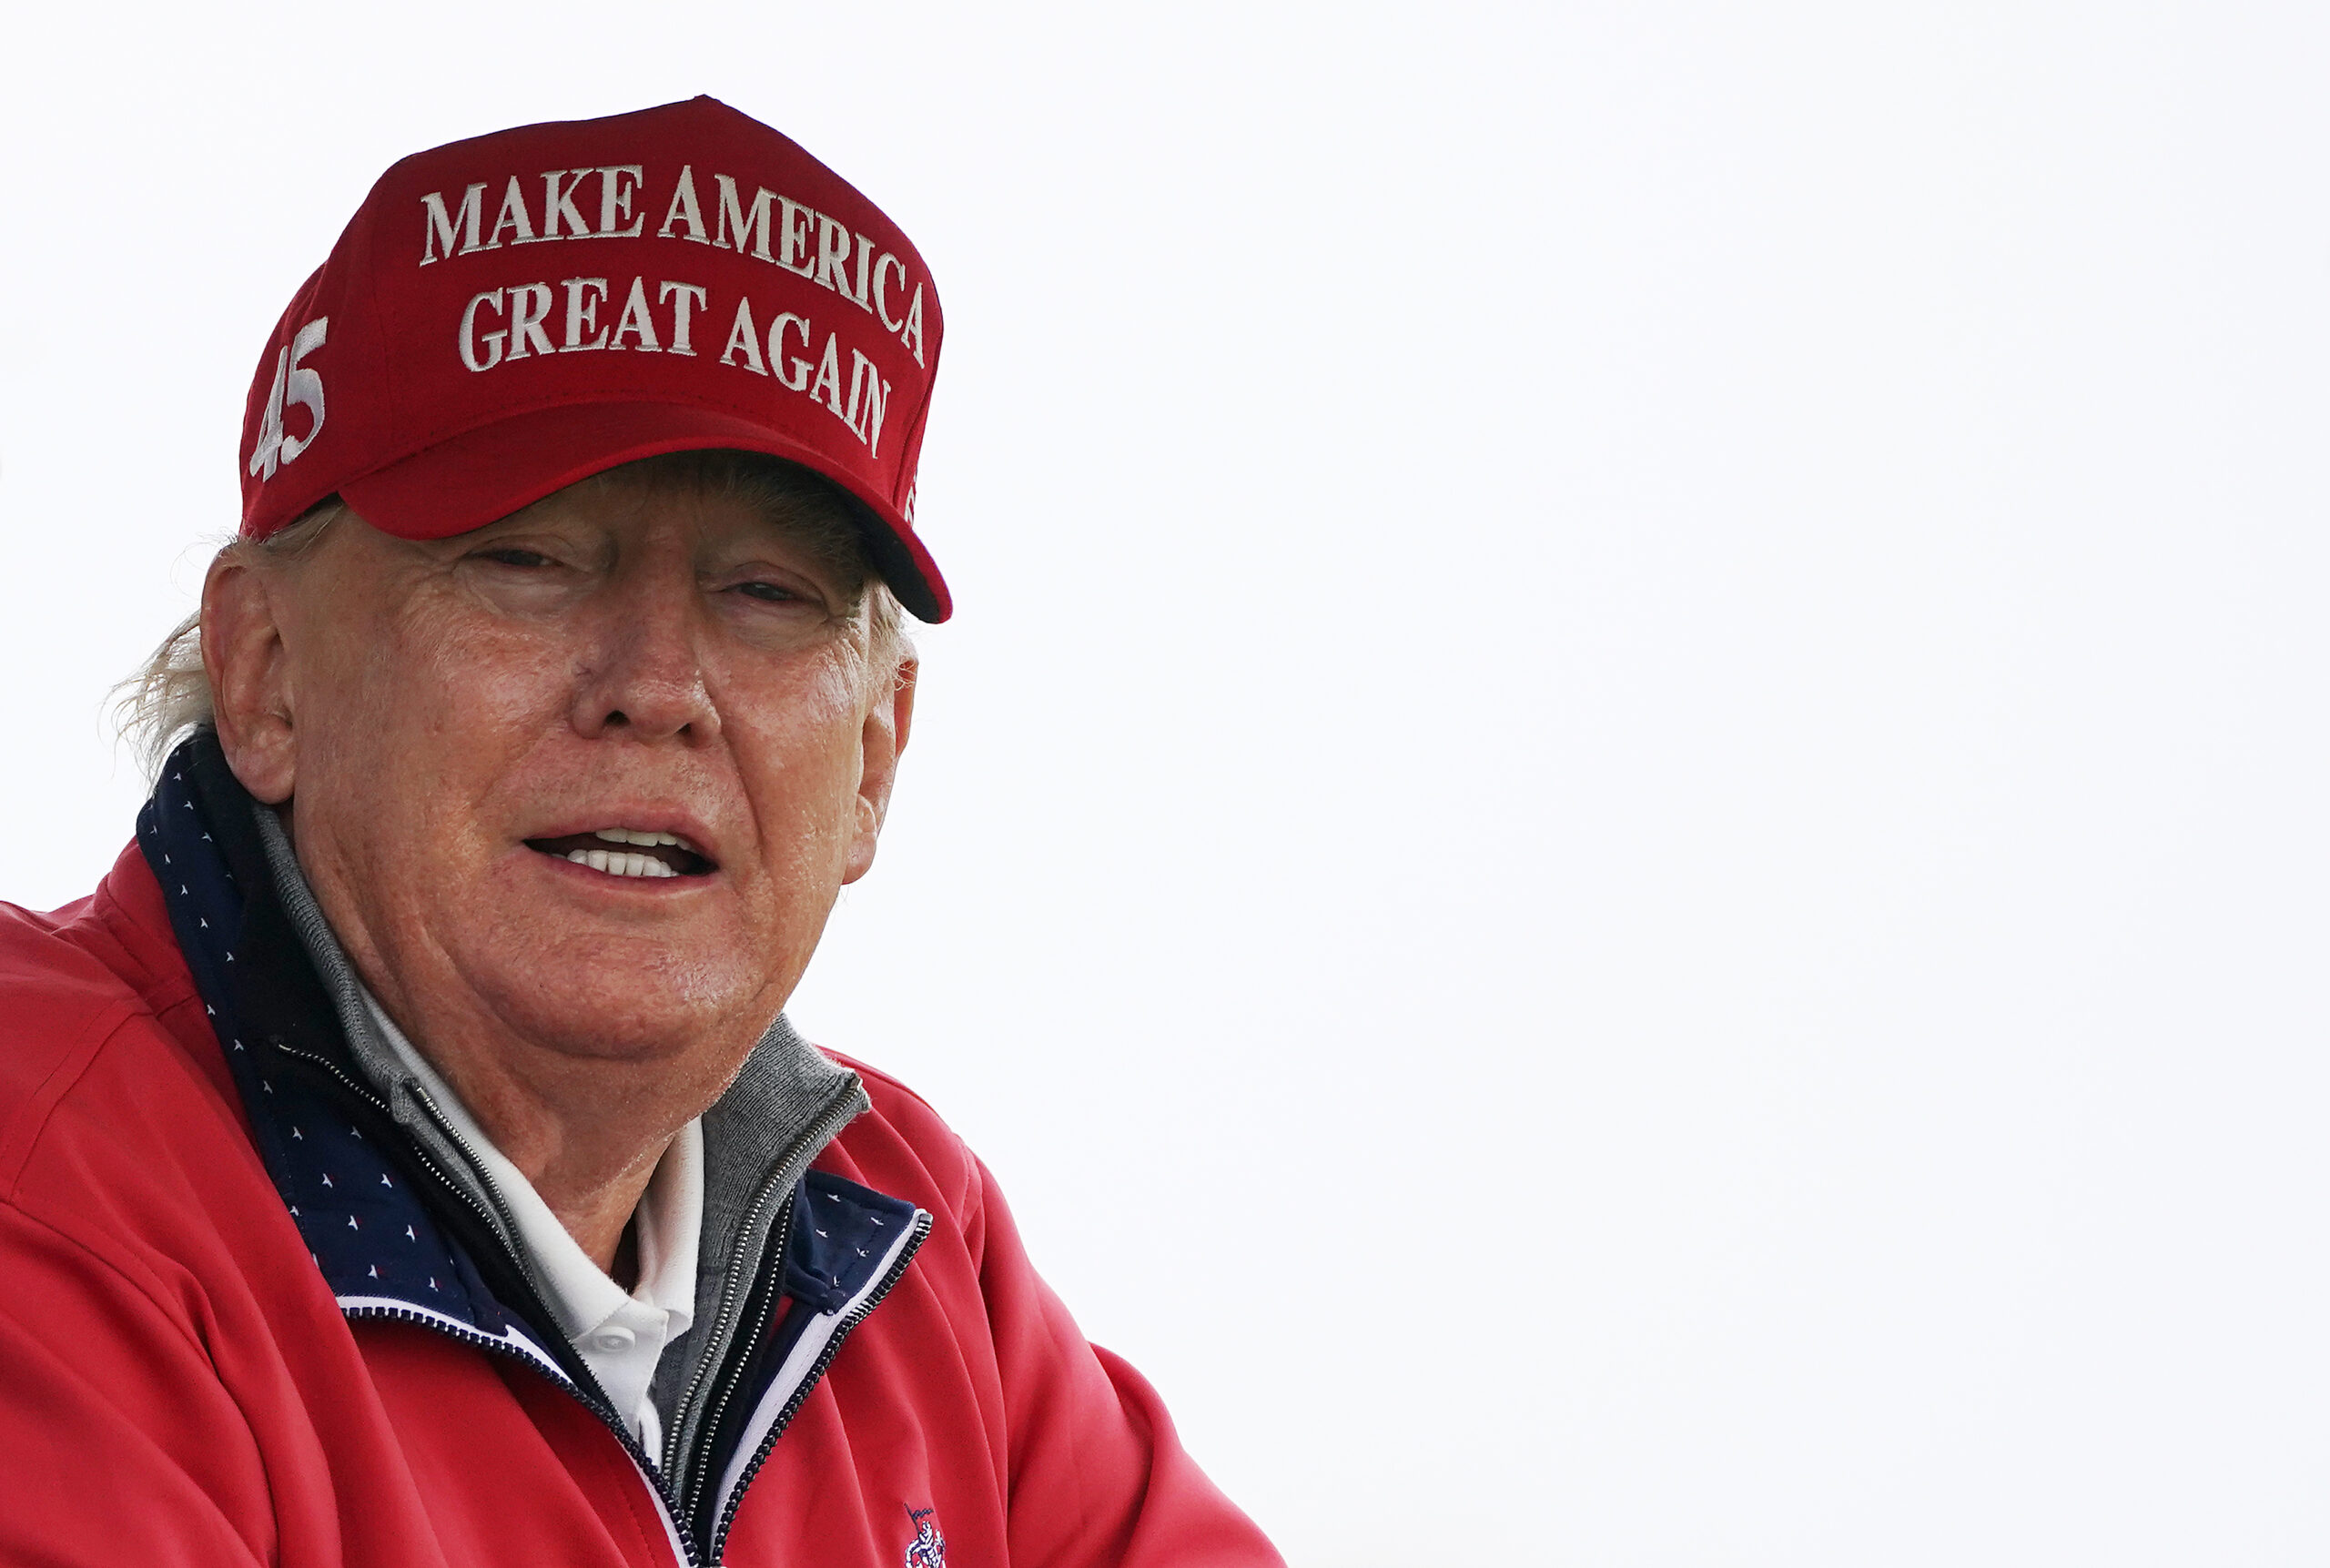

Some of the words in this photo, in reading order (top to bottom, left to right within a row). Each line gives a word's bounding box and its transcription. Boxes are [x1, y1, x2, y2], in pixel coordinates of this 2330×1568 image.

[420, 165, 645, 268] MAKE
[657, 165, 925, 369] AMERICA
[249, 316, 329, 482] 45
[459, 276, 708, 372] GREAT
[720, 297, 891, 459] AGAIN
